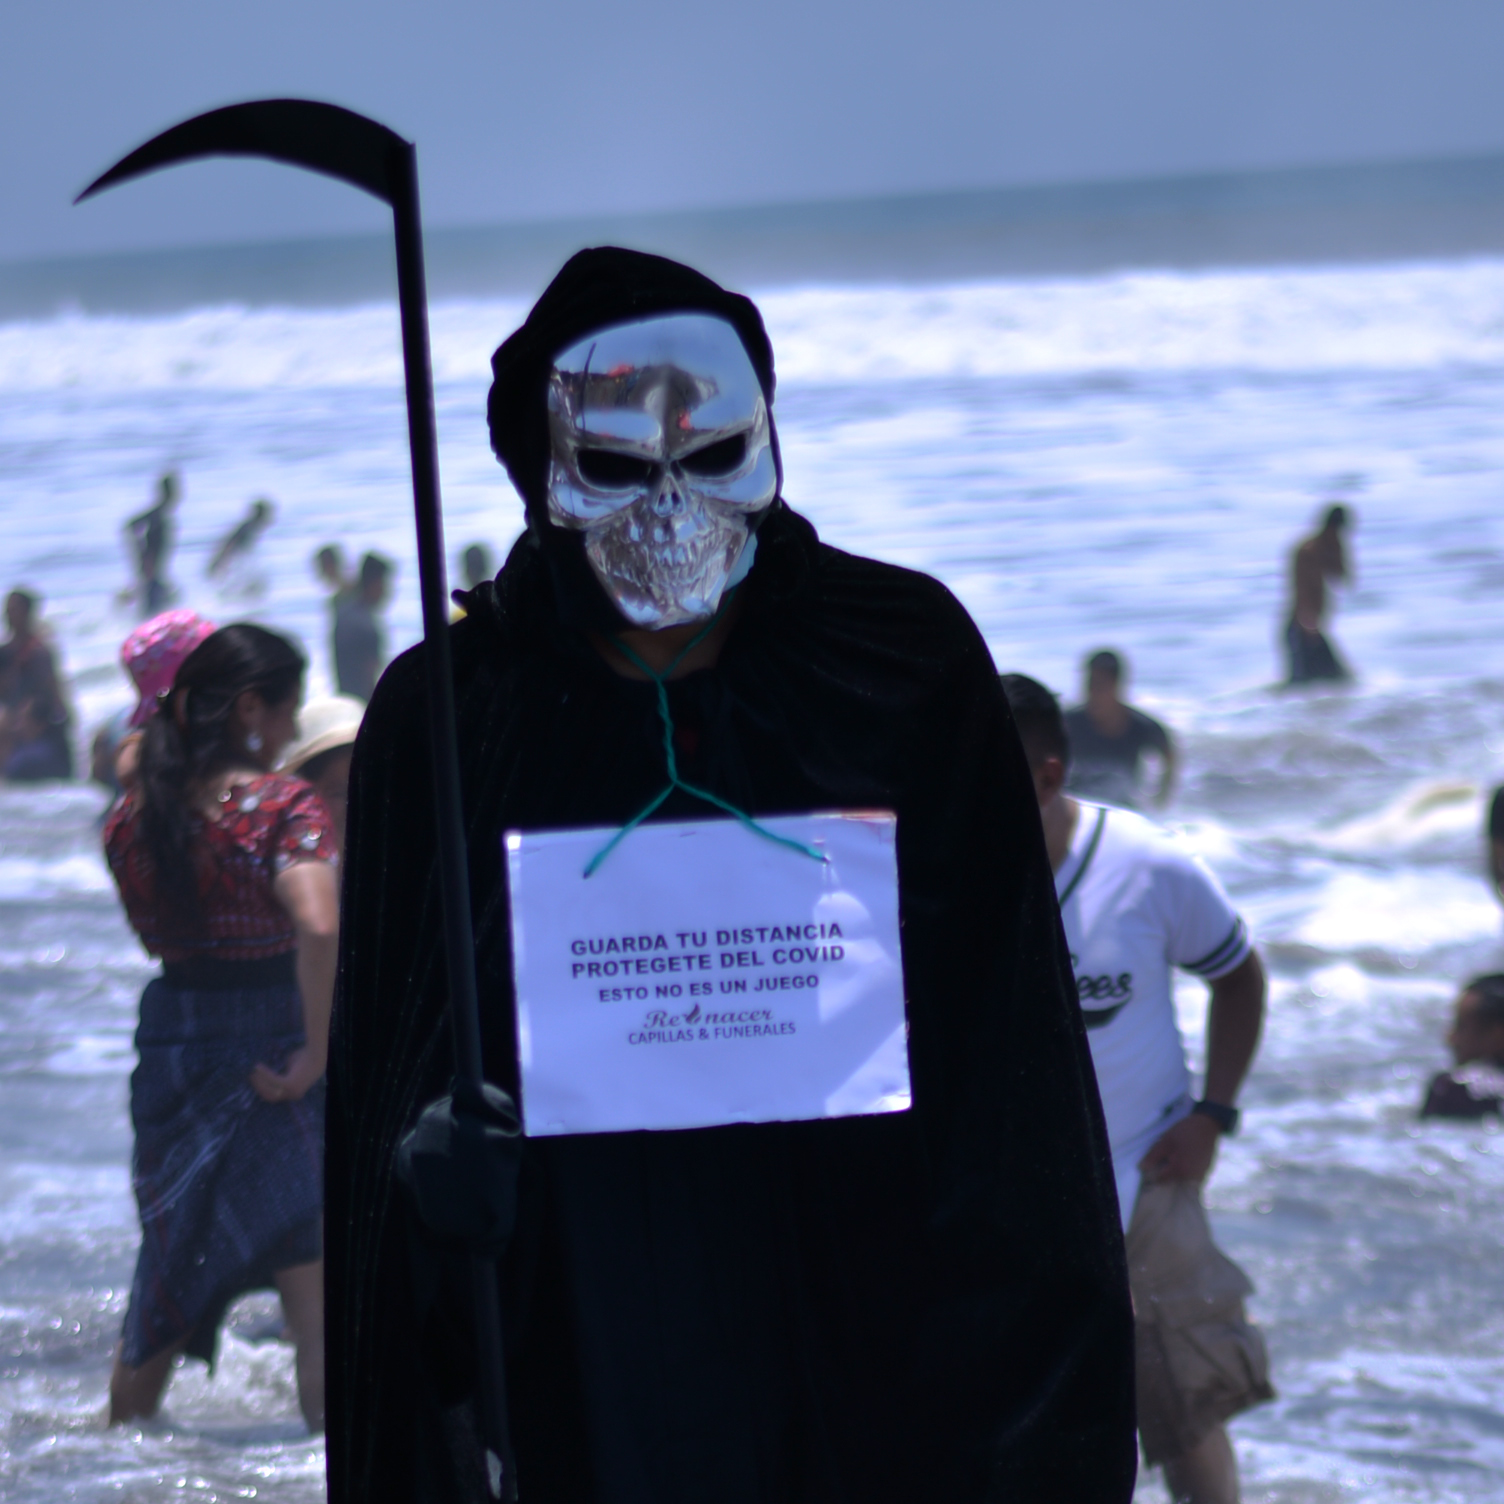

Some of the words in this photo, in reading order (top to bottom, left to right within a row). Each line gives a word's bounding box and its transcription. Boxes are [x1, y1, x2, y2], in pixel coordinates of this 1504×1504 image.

[571, 935, 668, 955] GUARDA
[676, 931, 707, 949] TU
[716, 922, 844, 946] DISTANCIA
[572, 954, 712, 979] PROTEGETE
[720, 950, 765, 969] DEL
[772, 945, 845, 965] COVID
[599, 986, 649, 1002] ESTO
[656, 984, 683, 999] NO
[690, 982, 713, 996] ES
[720, 979, 747, 994] UN
[754, 975, 820, 992] JUEGO
[628, 1028, 694, 1045] CAPILLAS
[698, 1027, 710, 1041] &
[714, 1023, 796, 1039] FUNERALES
